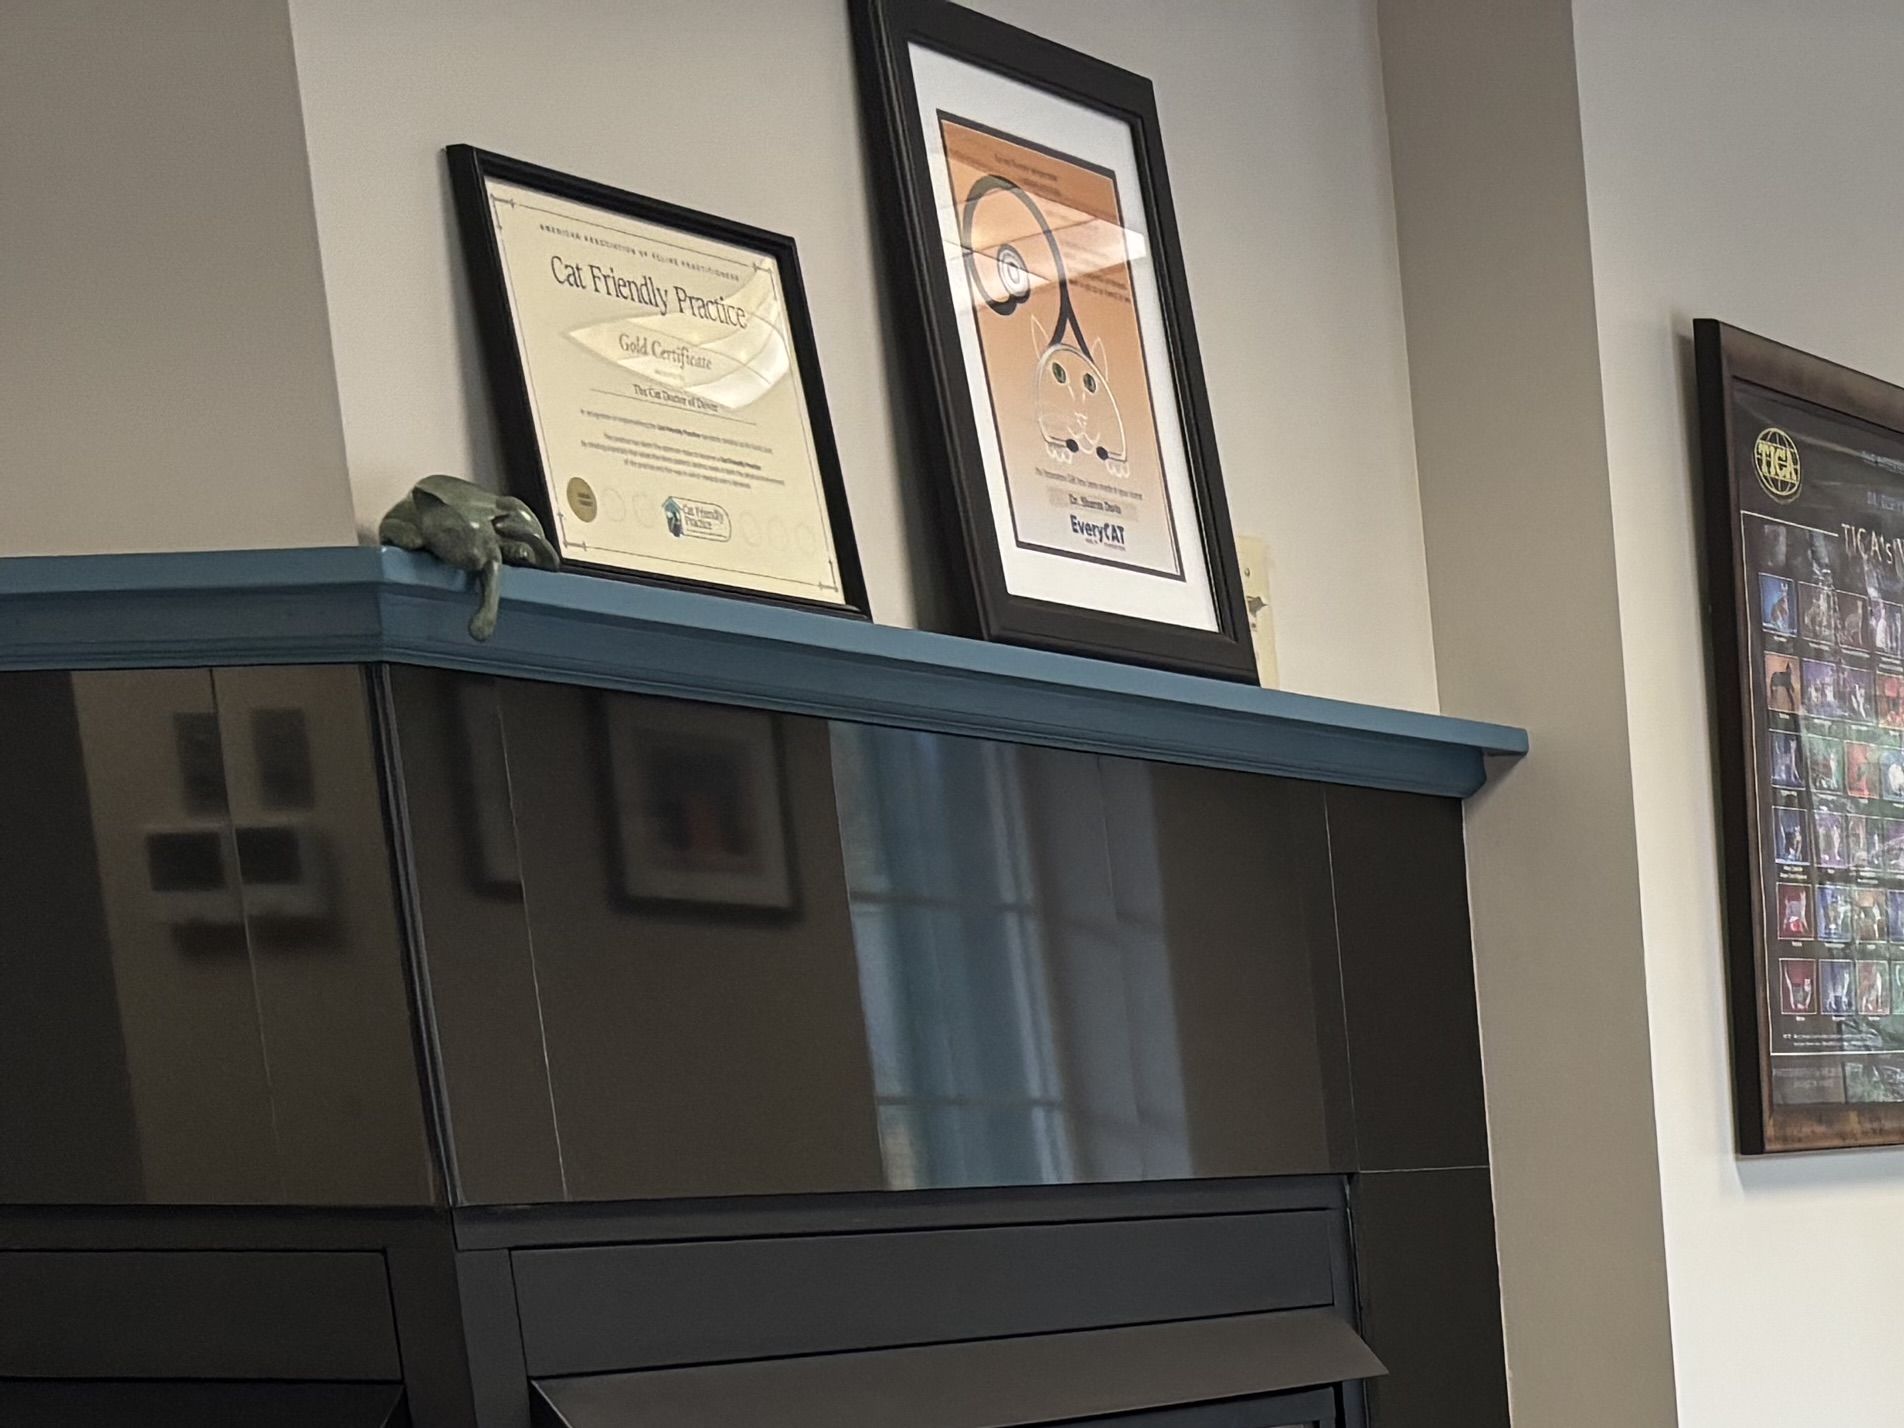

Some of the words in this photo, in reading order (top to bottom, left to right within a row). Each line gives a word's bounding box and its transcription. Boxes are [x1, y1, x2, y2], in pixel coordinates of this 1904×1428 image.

[551, 255, 586, 290] Cat
[588, 263, 668, 316] Friendly
[673, 285, 748, 329] Practice
[619, 333, 648, 356] Gold
[651, 340, 712, 369] Certificate
[1758, 443, 1797, 482] TICA
[1069, 513, 1125, 545] EveryCAT
